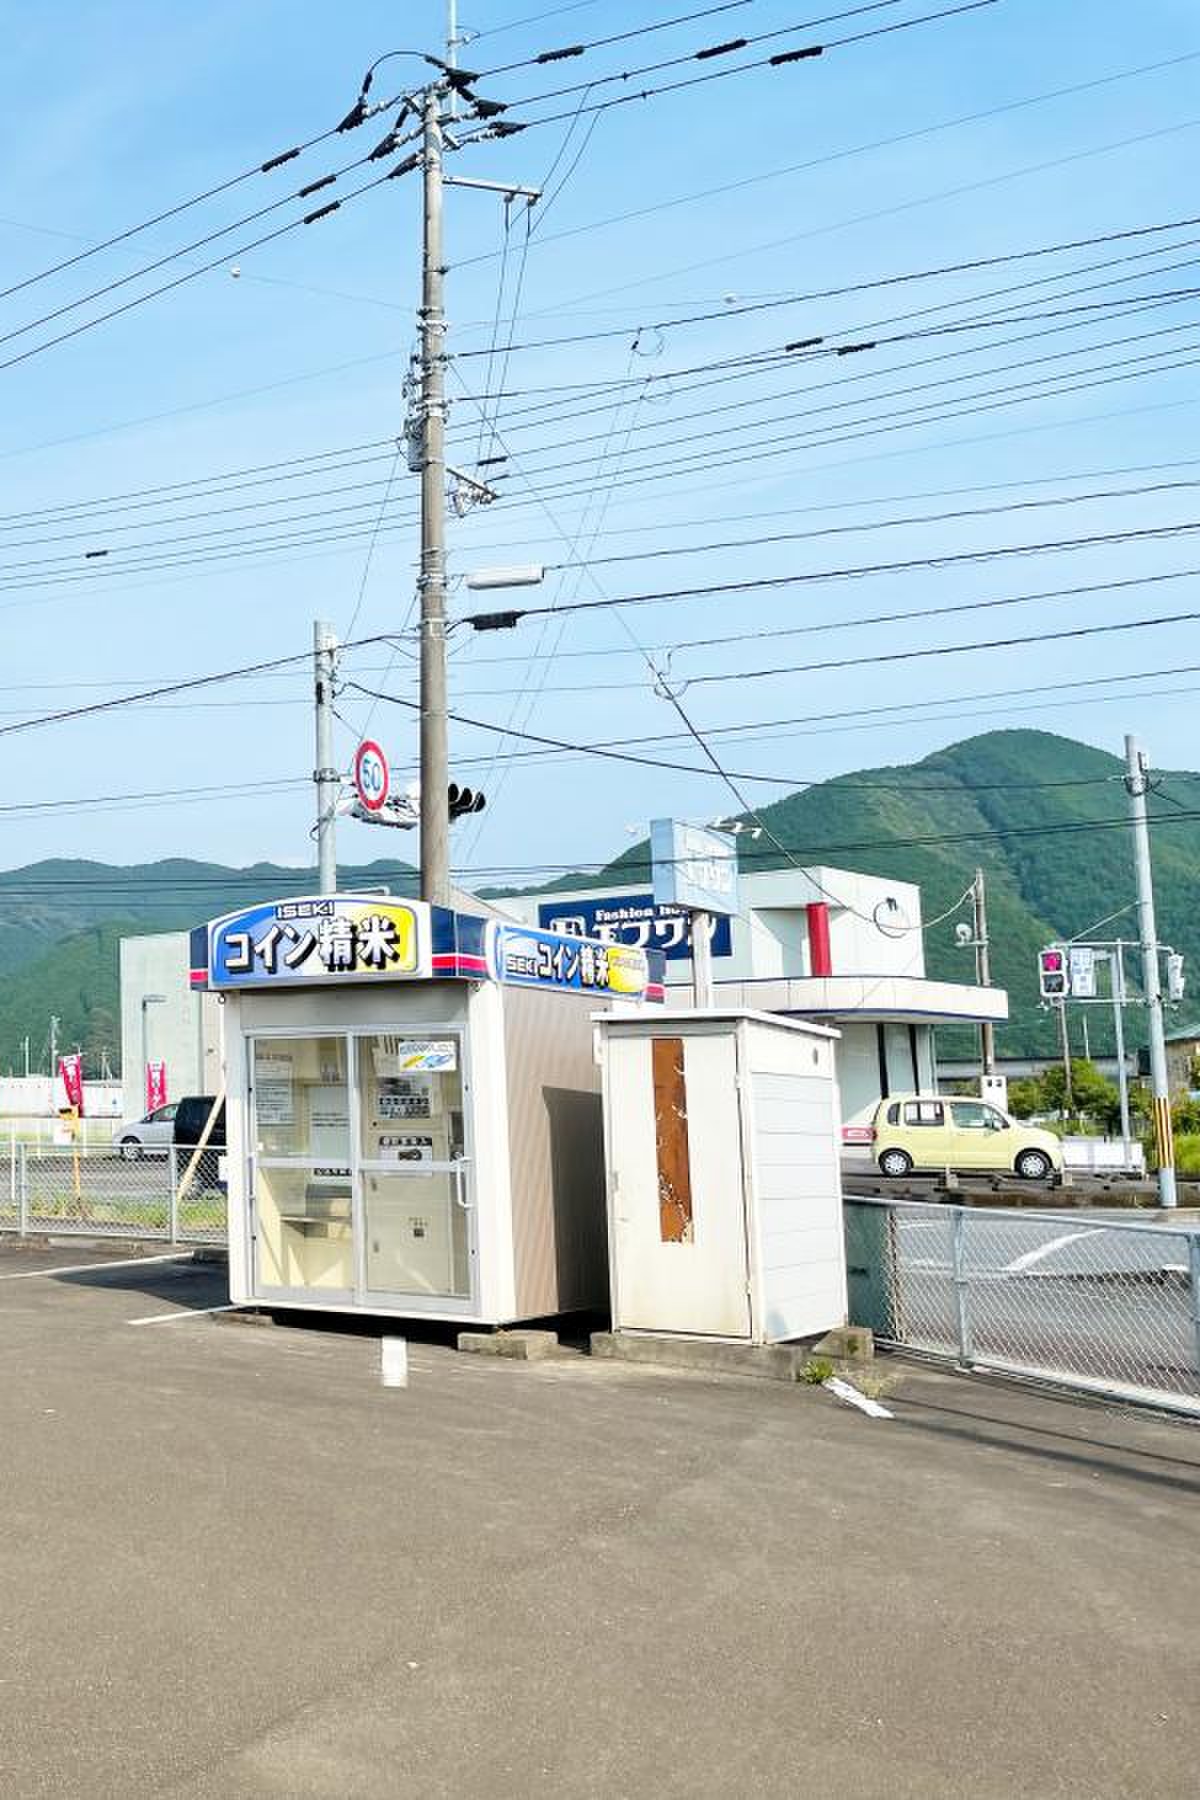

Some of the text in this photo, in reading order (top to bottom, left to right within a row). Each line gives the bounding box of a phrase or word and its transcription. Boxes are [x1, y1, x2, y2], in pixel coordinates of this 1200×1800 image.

[362, 757, 382, 792] 50
[276, 901, 334, 920] ISEKI
[595, 907, 654, 922] Fashion
[224, 915, 399, 973] コイン精米
[505, 954, 539, 976] SEKI
[538, 943, 609, 987] コイン精米
